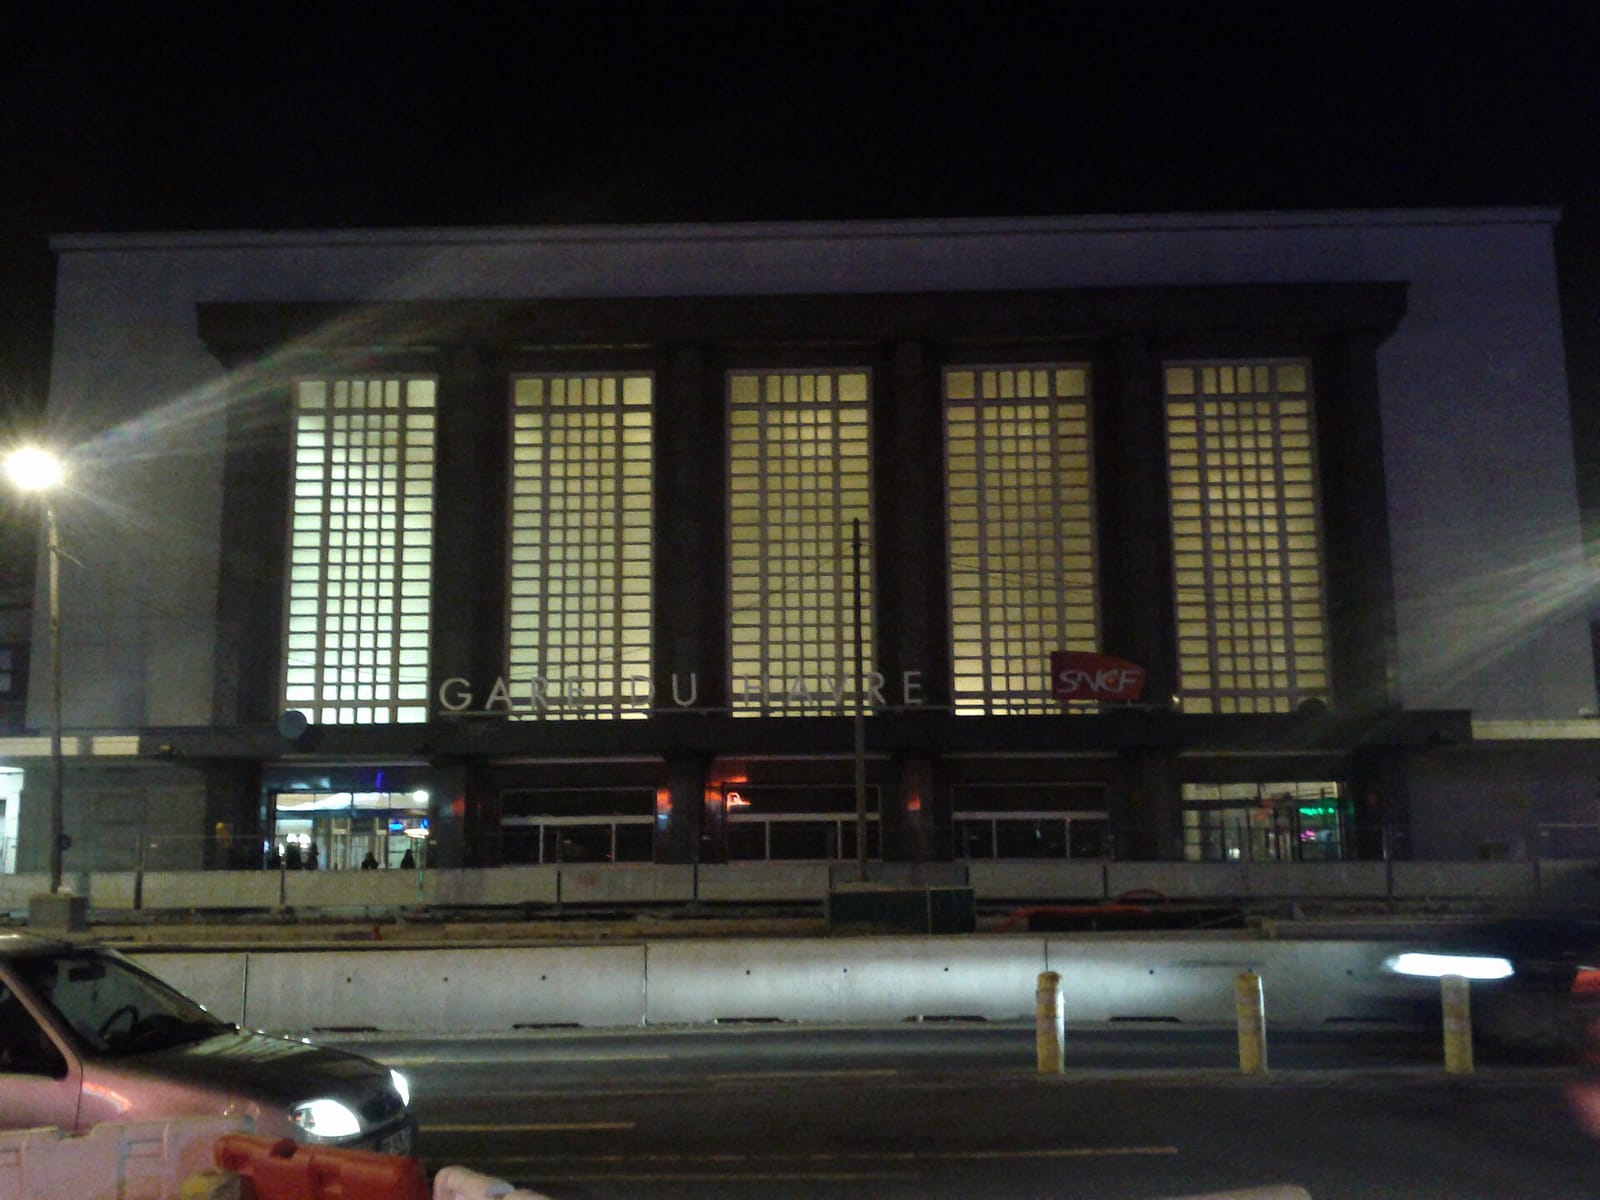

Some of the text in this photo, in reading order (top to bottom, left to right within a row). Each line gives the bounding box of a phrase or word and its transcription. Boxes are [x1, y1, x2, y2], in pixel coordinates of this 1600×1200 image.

[438, 670, 923, 711] GARE DU HAVRE
[1056, 668, 1140, 693] SNCF
